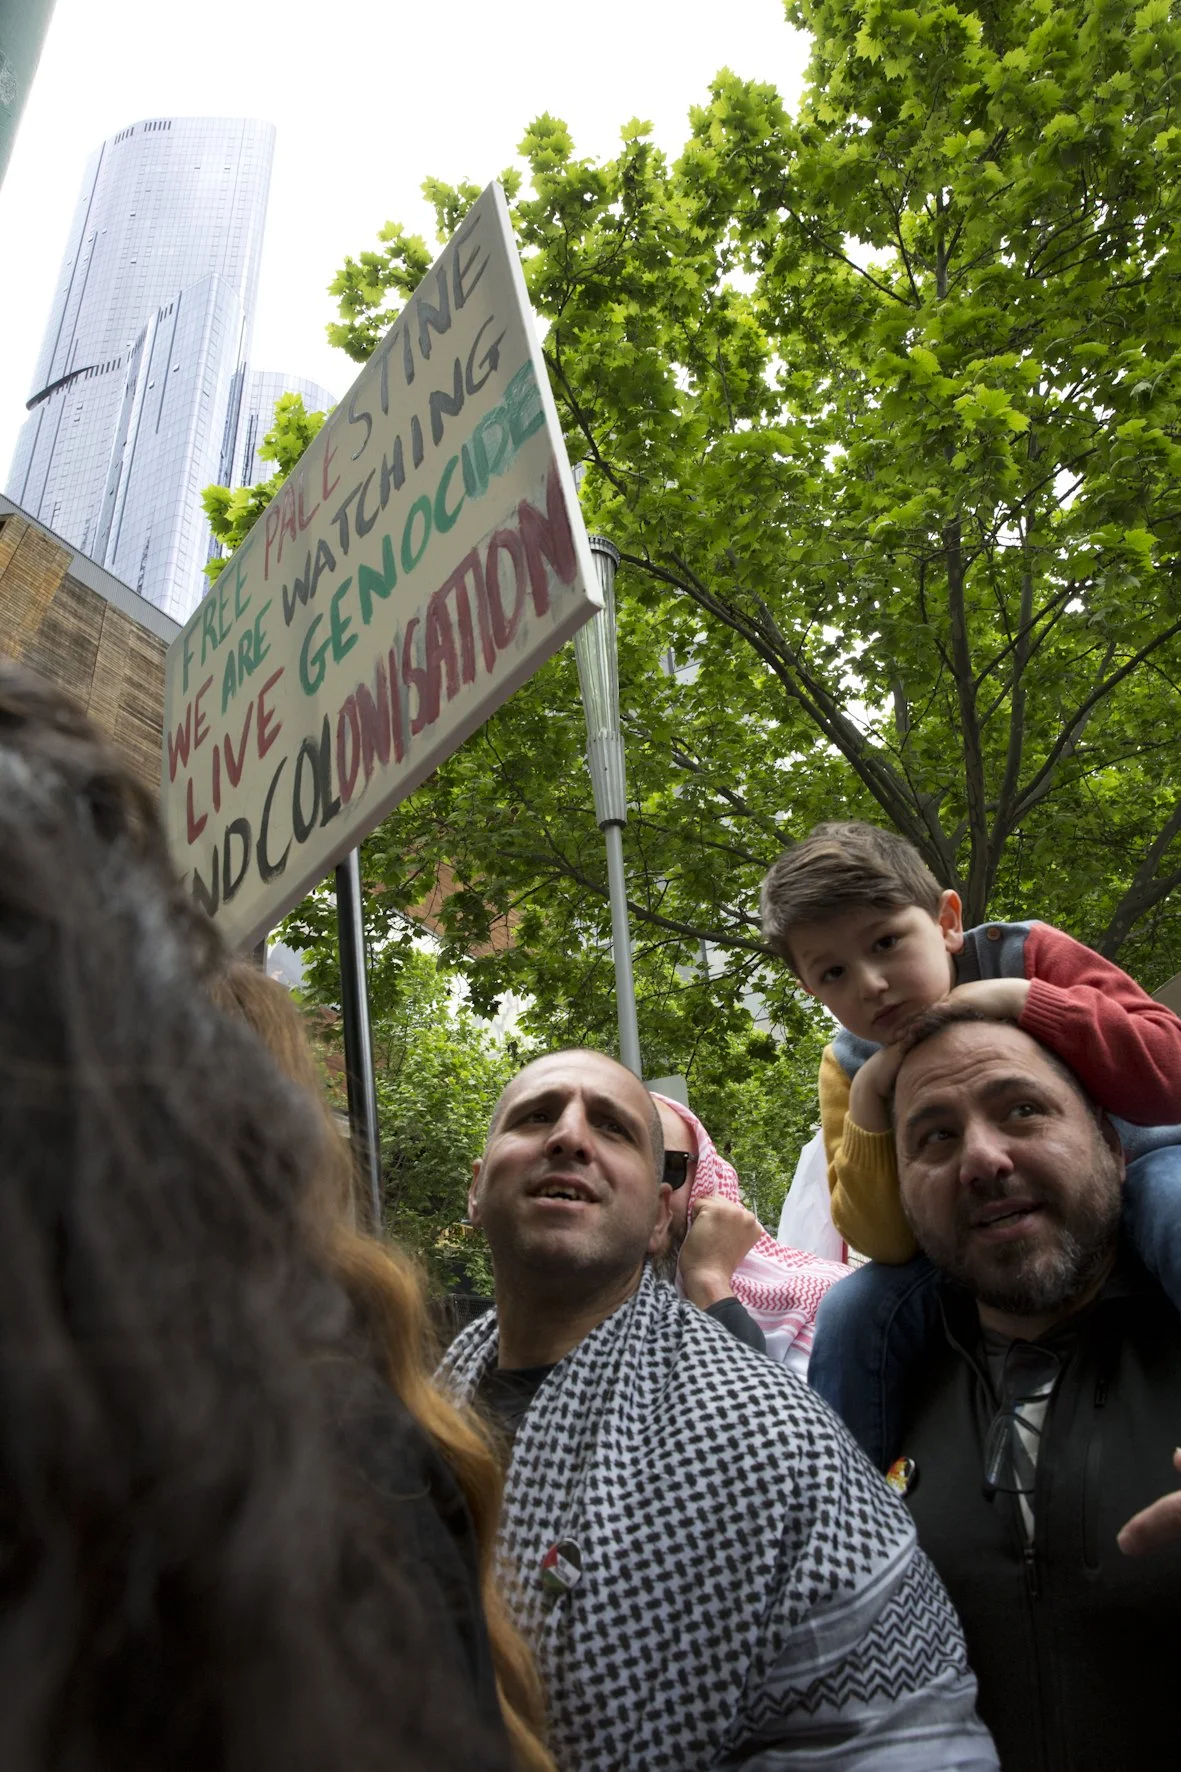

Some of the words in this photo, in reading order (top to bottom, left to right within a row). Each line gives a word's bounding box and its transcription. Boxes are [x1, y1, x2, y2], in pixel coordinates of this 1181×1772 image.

[168, 675, 213, 783] WE
[221, 597, 272, 716] ARE
[282, 315, 506, 627] WATCHING
[183, 533, 257, 696] FREE
[265, 214, 491, 580] PALESTINE
[187, 666, 285, 845] LIVE
[300, 359, 546, 696] GENOCIDE
[179, 817, 252, 918] ND
